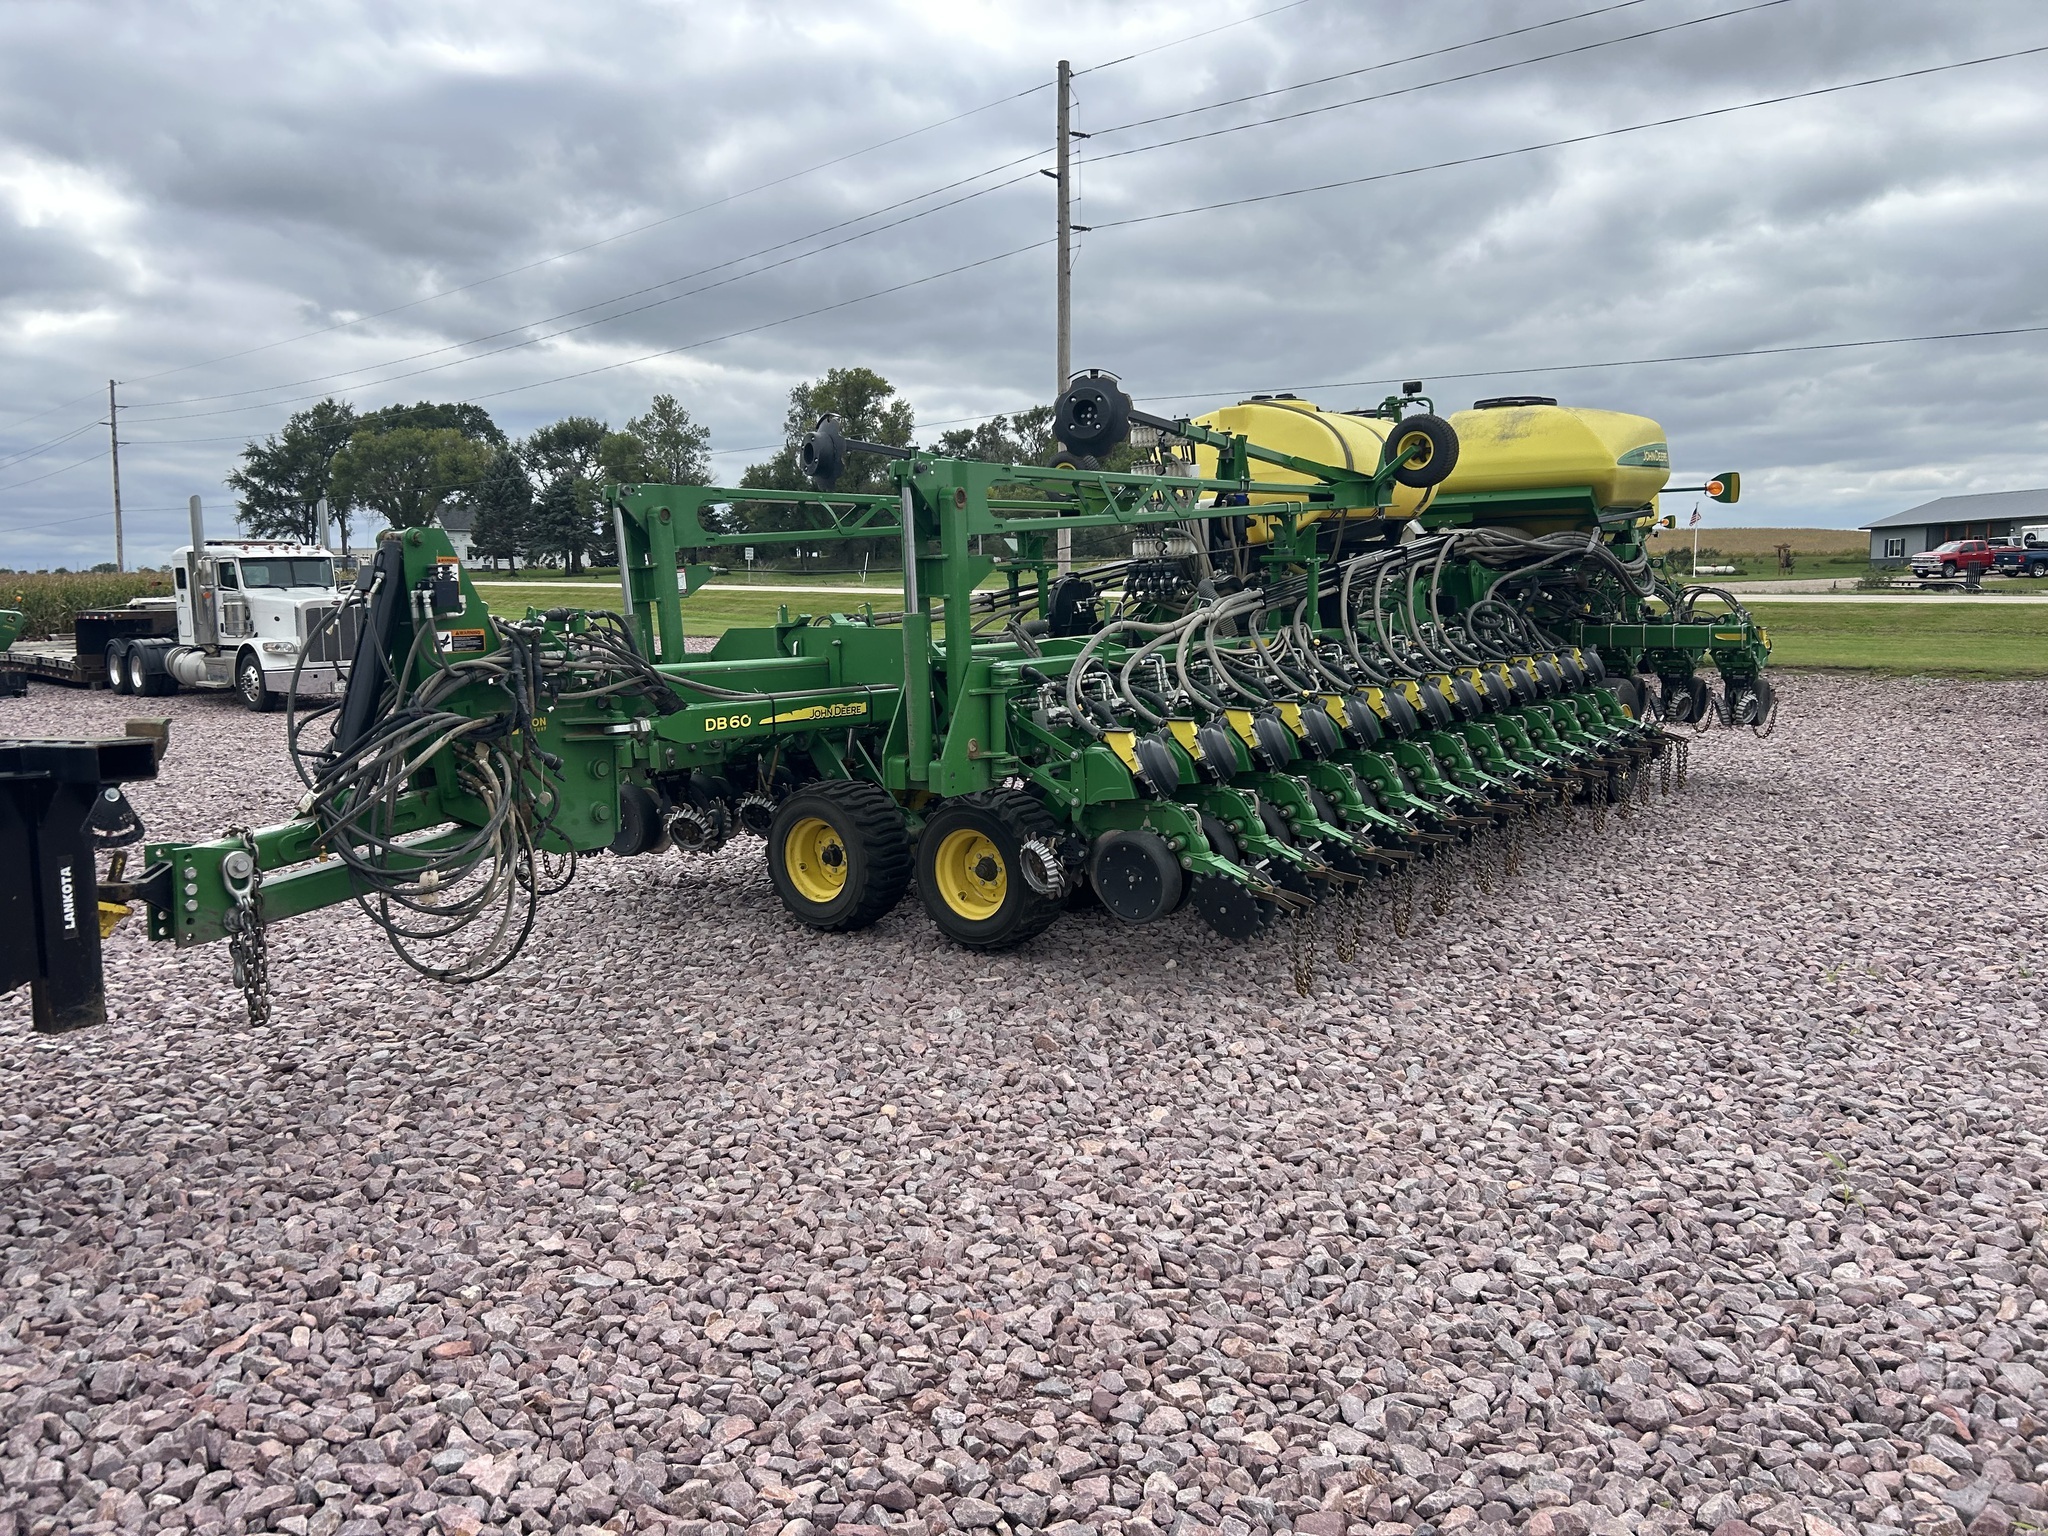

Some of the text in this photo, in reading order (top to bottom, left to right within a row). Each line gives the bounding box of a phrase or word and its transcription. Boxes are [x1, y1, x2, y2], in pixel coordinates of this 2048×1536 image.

[809, 705, 862, 720] JOHN DEERE
[60, 866, 76, 930] LANKOTA
